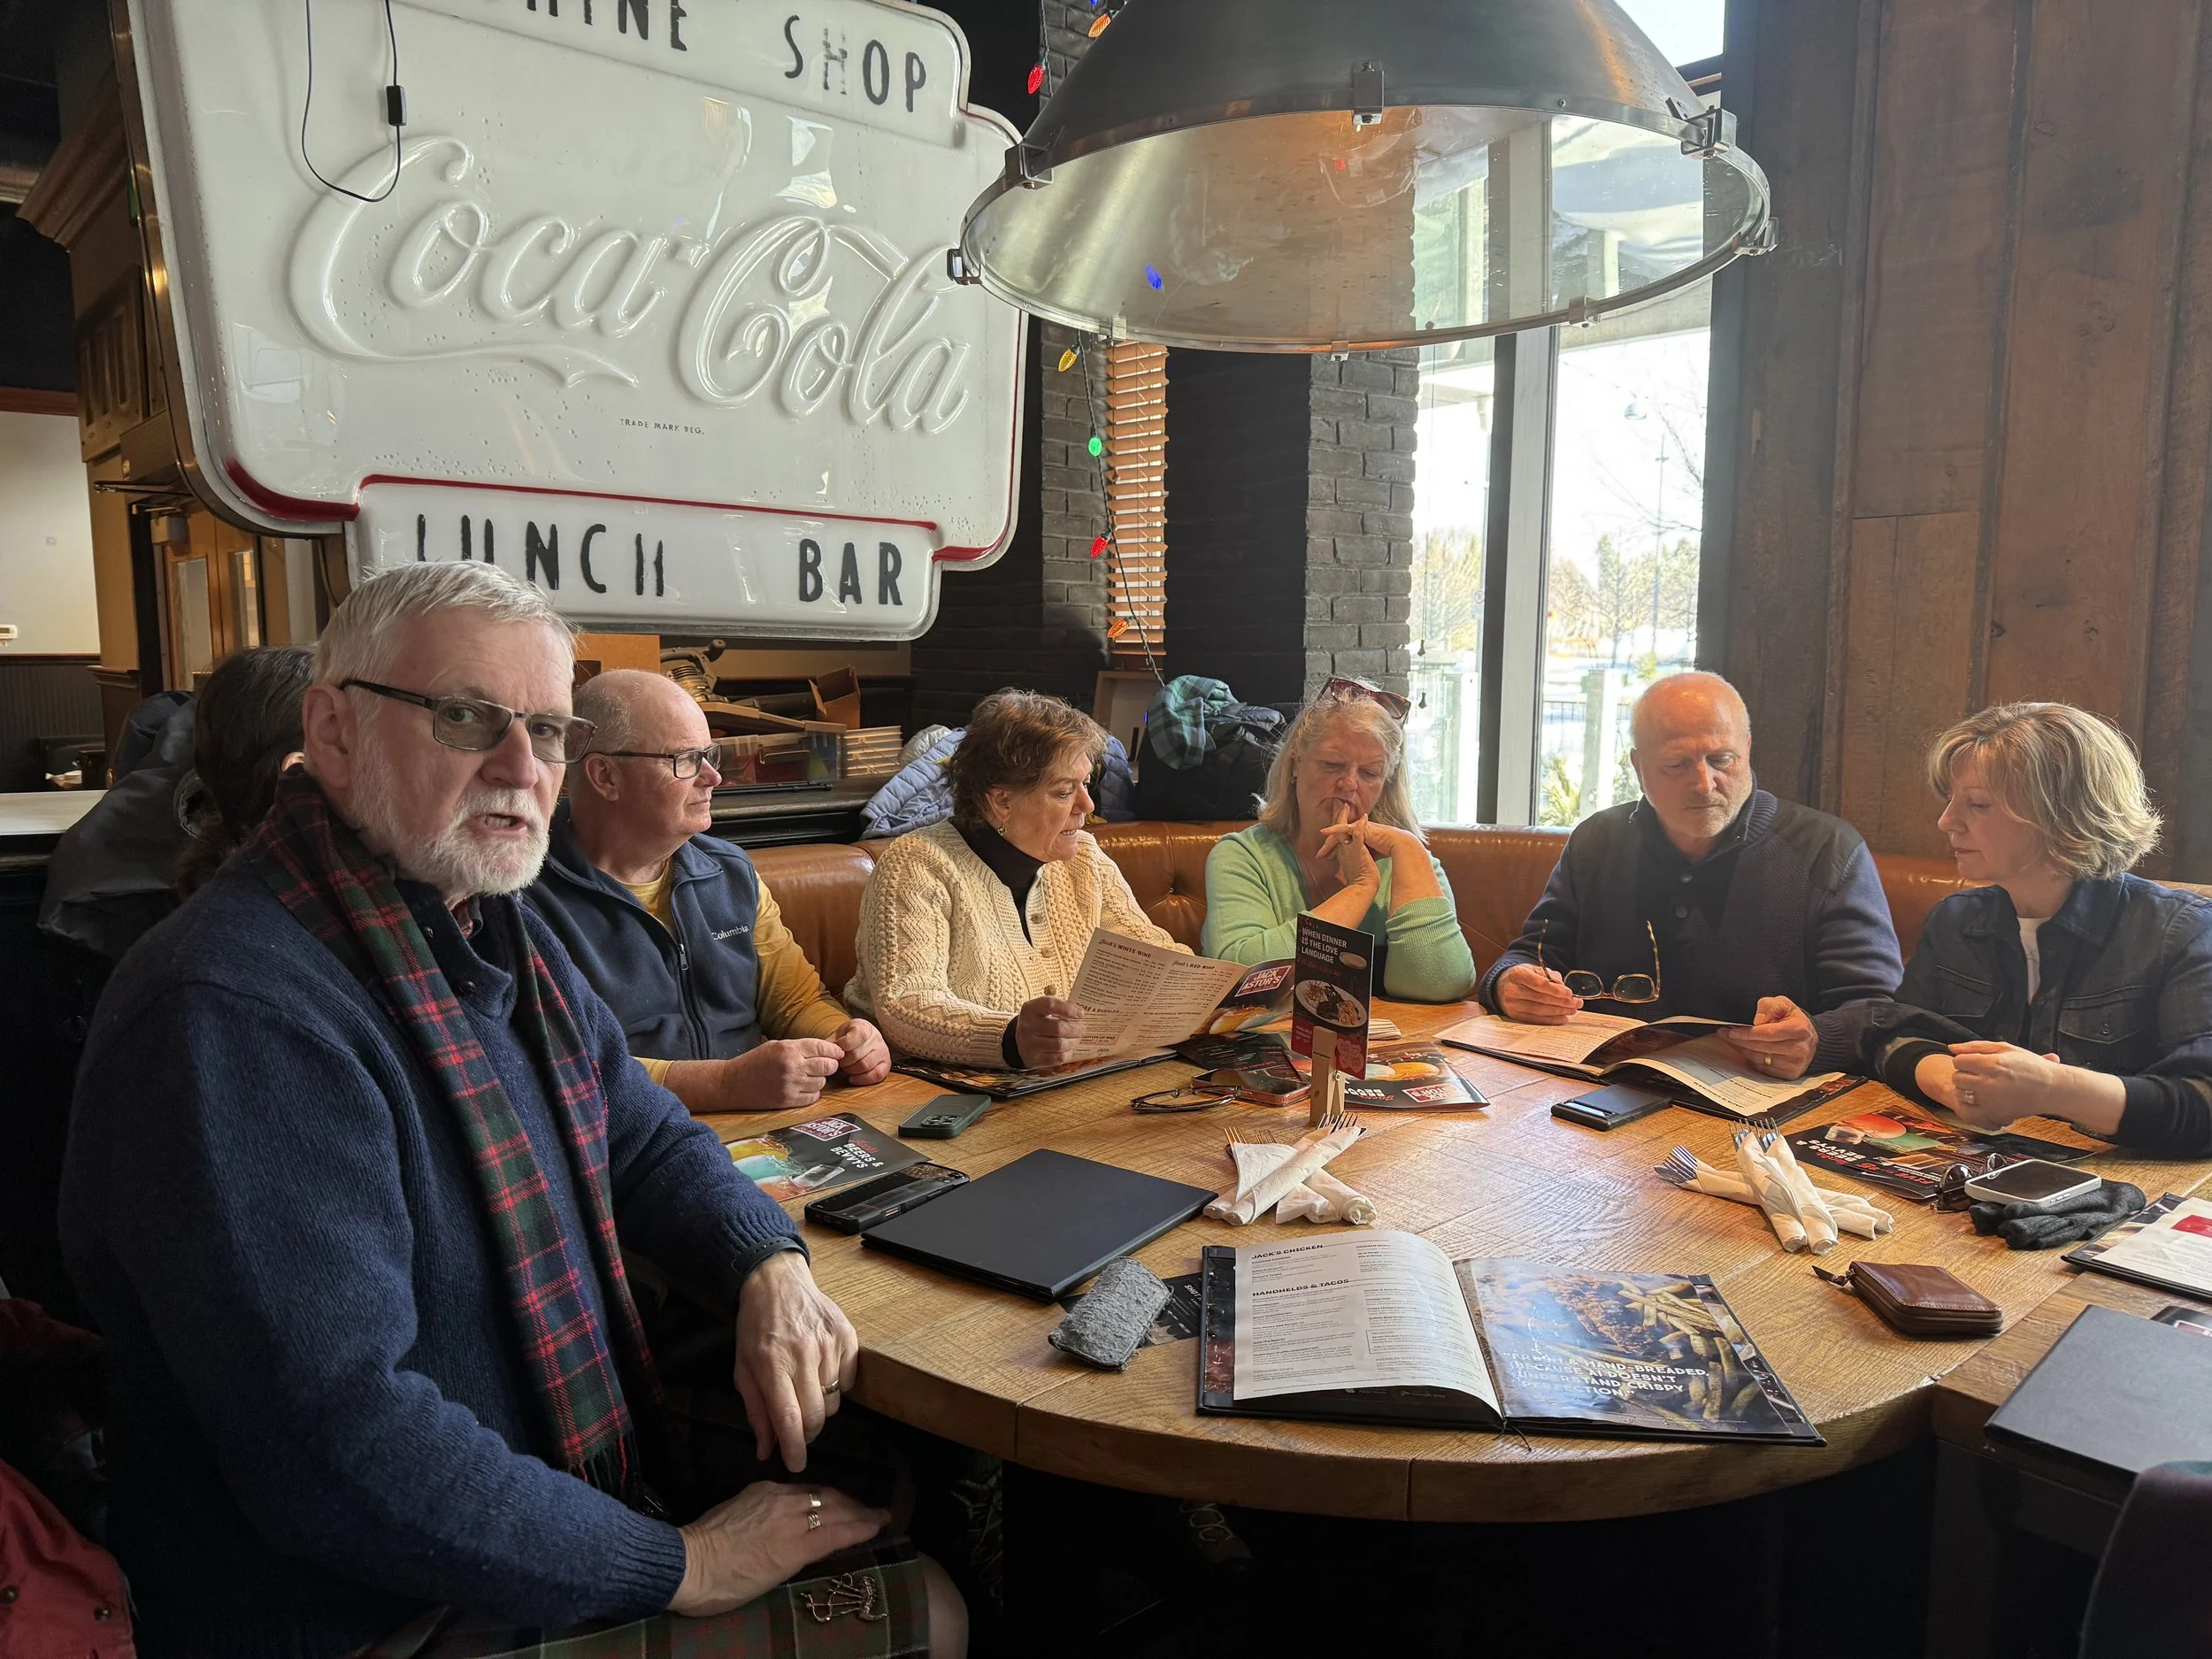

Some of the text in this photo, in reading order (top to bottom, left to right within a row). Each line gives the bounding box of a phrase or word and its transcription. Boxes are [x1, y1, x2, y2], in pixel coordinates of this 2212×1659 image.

[784, 15, 926, 112] SHOP
[619, 419, 705, 435] TRADE MARK REG.
[798, 537, 903, 606] BAR
[710, 925, 750, 941] Columbia
[1302, 927, 1348, 949] WHEN DINNER
[1118, 944, 1136, 954] WHITE
[1137, 950, 1152, 959] WINE
[1301, 947, 1334, 964] LANGUAGE
[1302, 936, 1339, 956] IS THE LOVE
[1241, 975, 1282, 991] ASTOR'S
[1253, 969, 1279, 980] JACK
[829, 1146, 869, 1169] BEVVYS
[843, 1142, 876, 1163] BEERS
[1809, 1139, 1867, 1160] BEVVYS
[1809, 1145, 1858, 1163] BEERS
[1251, 1244, 1324, 1260] JACK'S CHICKEN
[1252, 1285, 1309, 1297] HANDHELDS
[1515, 1360, 1676, 1383] BECAUSE AI DOESN'T
[1518, 1371, 1684, 1393] UNDERSTAND CRISPY
